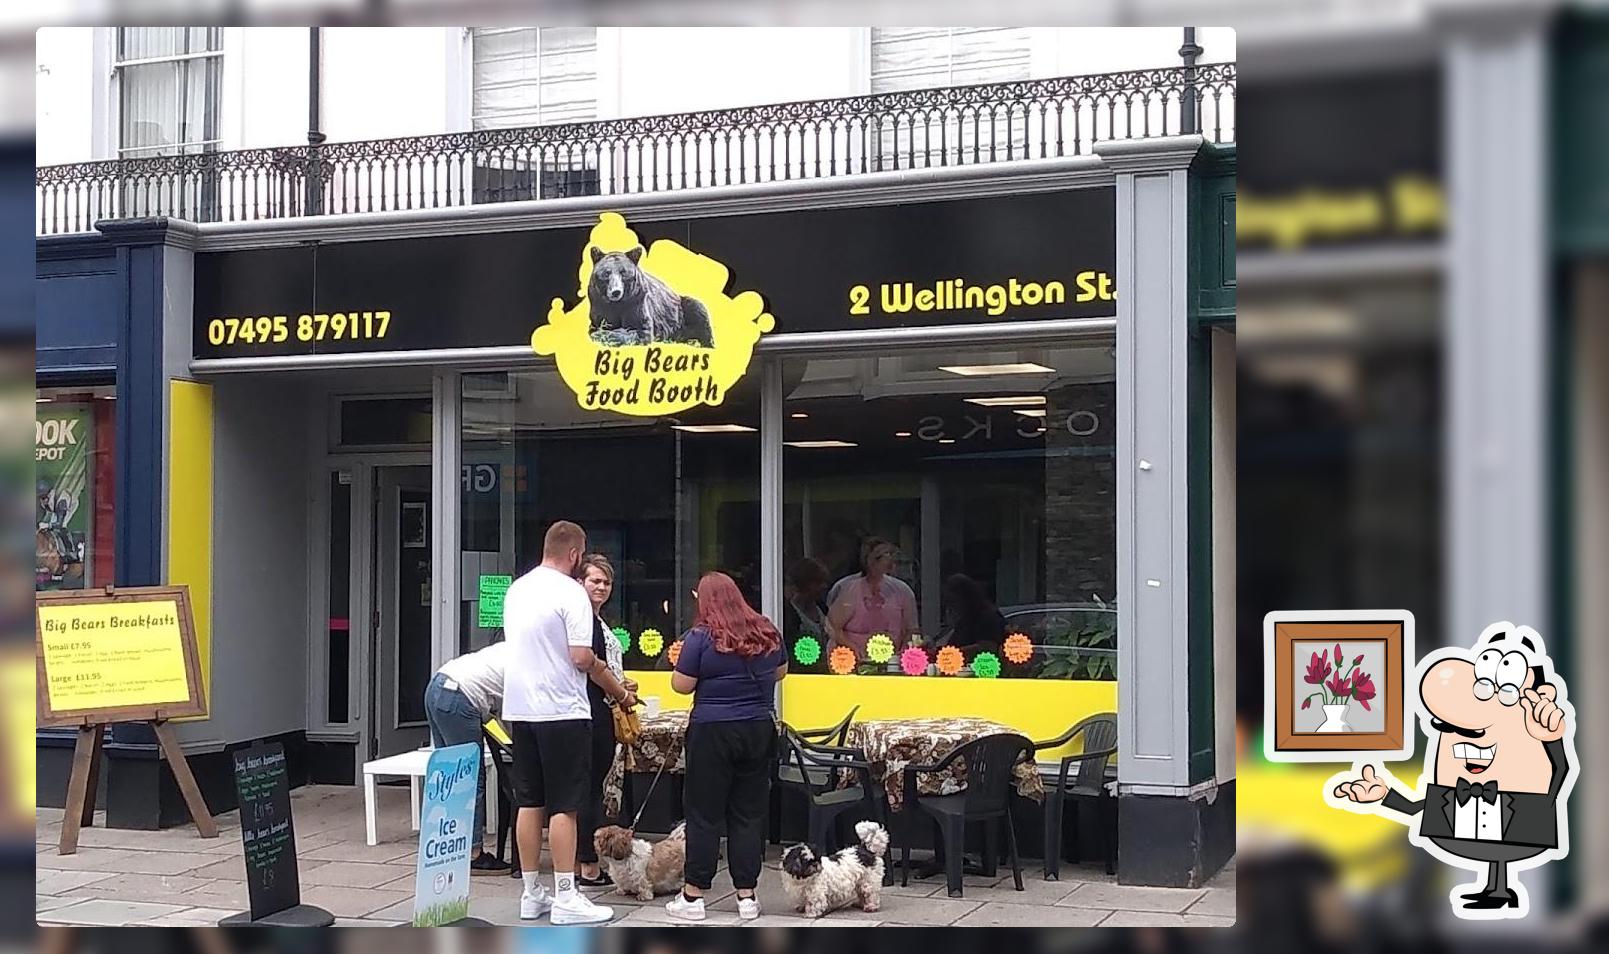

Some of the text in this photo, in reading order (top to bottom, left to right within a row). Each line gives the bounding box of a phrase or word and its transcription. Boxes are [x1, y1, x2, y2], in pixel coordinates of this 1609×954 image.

[849, 271, 1118, 316] 2 Wellington St.
[208, 311, 391, 346] 07495 879117
[594, 347, 710, 381] Big Bears
[585, 375, 718, 406] Food Booth
[45, 614, 175, 633] Big Bears Breakfasts
[47, 643, 69, 651] Small
[51, 675, 72, 683] Large
[429, 758, 475, 802] Styles
[439, 817, 457, 837] Ice
[425, 835, 467, 859] Cream
